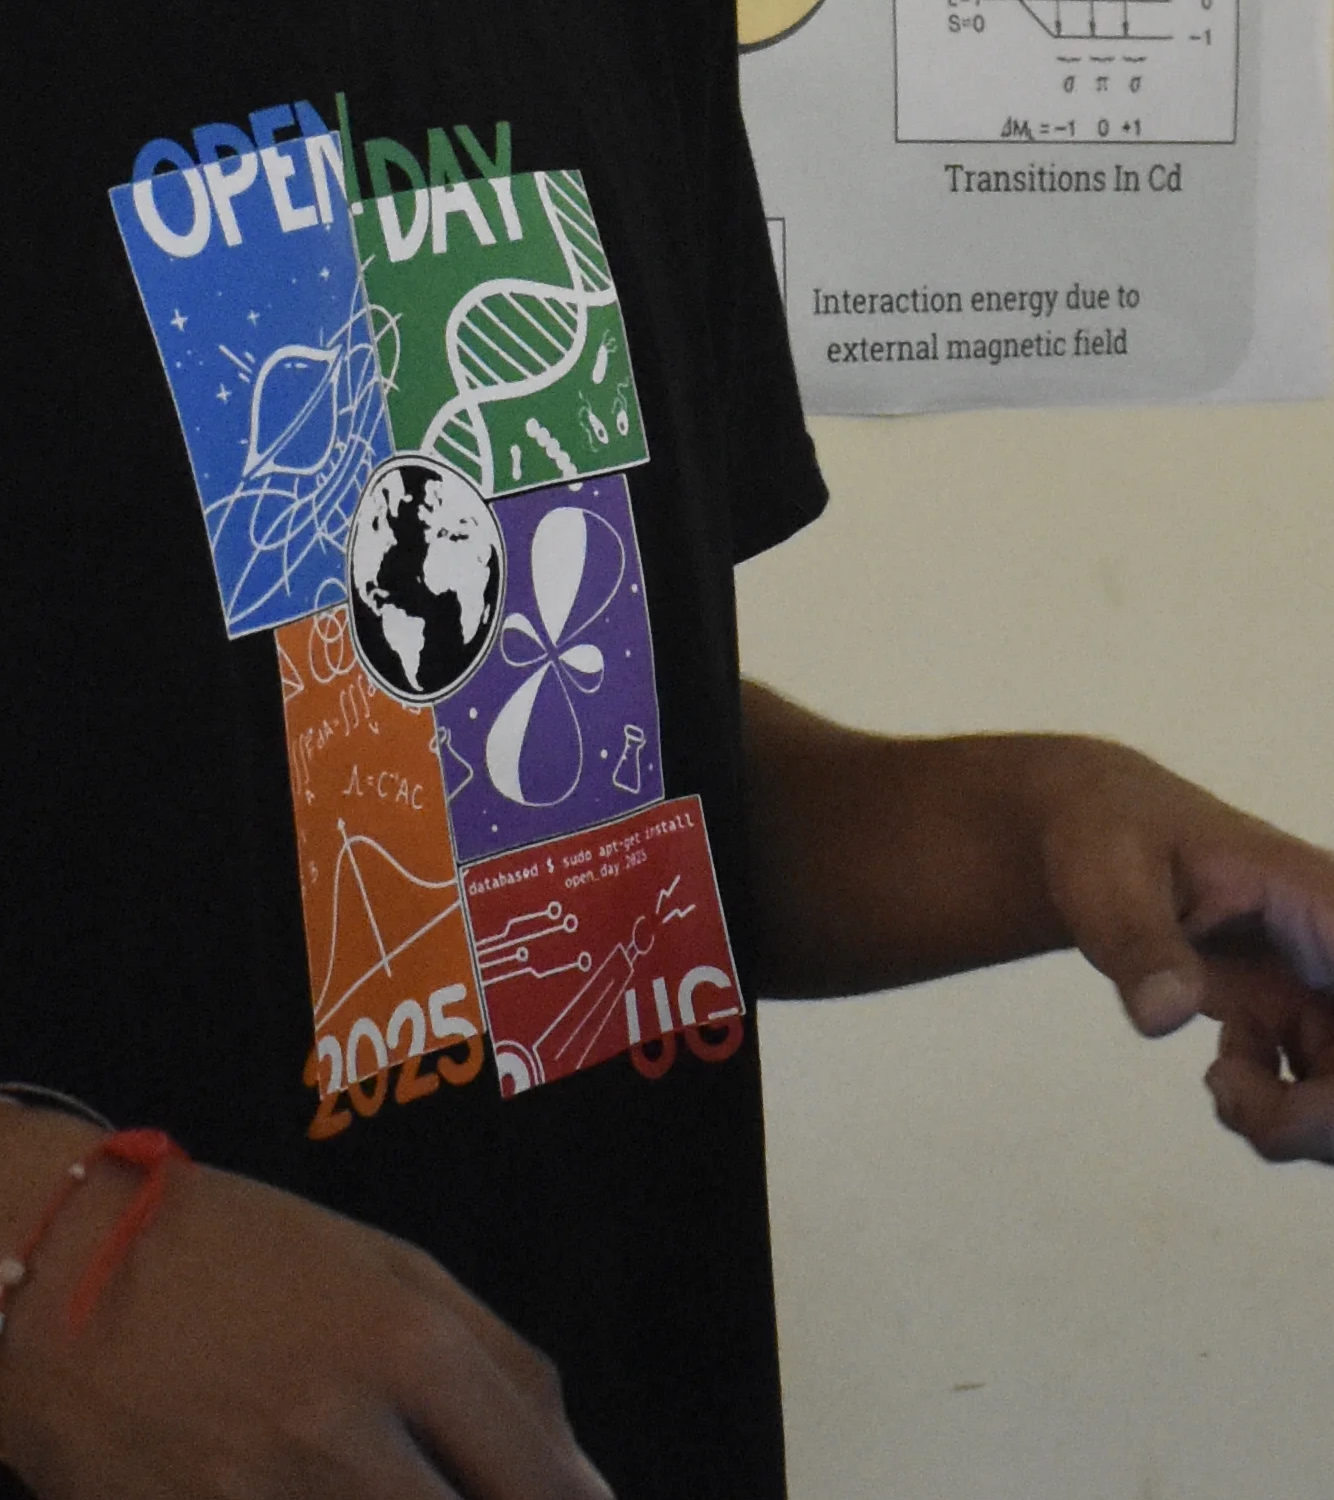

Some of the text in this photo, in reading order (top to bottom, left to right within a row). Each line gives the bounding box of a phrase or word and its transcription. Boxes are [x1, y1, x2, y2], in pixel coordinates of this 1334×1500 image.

[133, 92, 364, 258] OPEN
[365, 120, 523, 262] DAY
[944, 162, 1183, 194] Transitions In Cd
[813, 282, 1140, 318] Interaction energy due to
[827, 327, 1128, 366] external magnetic field
[562, 849, 593, 868] sudo
[626, 965, 745, 1078] UG
[304, 982, 485, 1140] 2025
